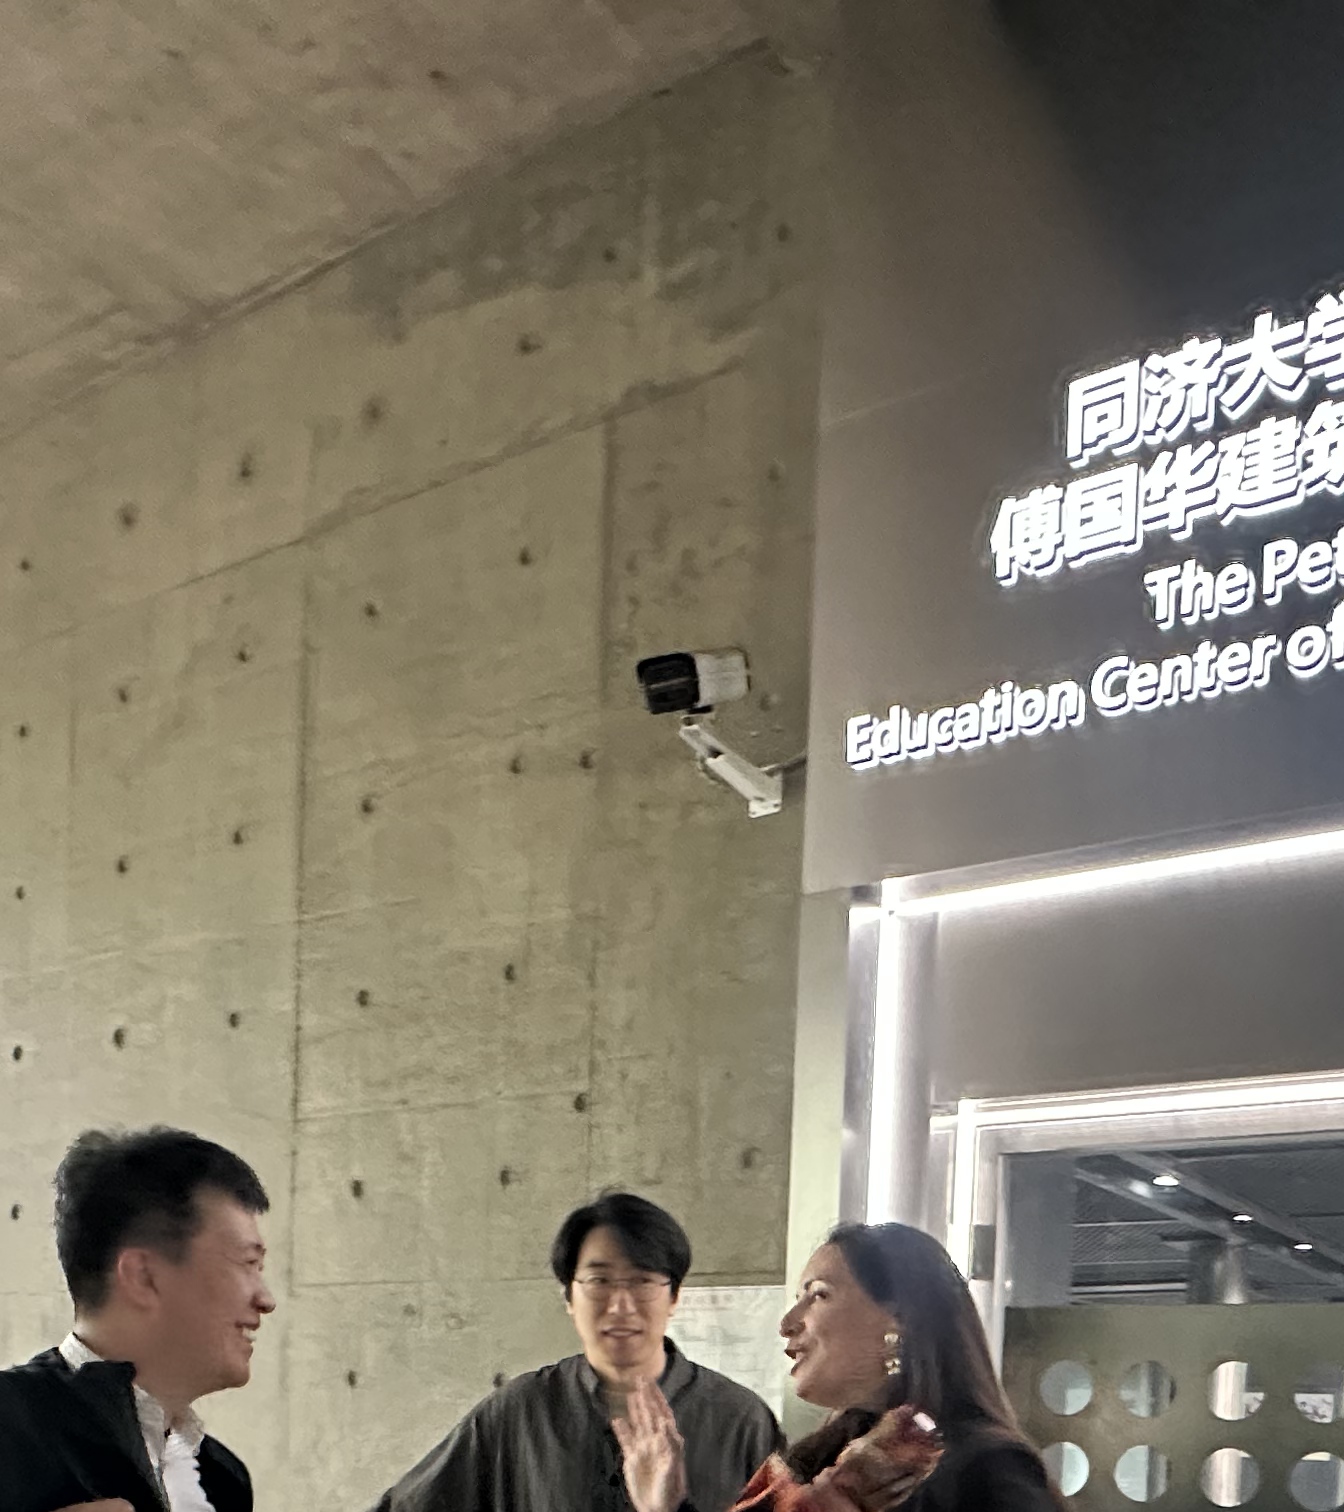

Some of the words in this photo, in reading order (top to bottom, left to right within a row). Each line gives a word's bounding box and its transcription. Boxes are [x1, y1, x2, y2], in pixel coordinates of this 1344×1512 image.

[1142, 557, 1256, 629] The
[846, 674, 1085, 770] Education
[1090, 636, 1288, 717] Center
